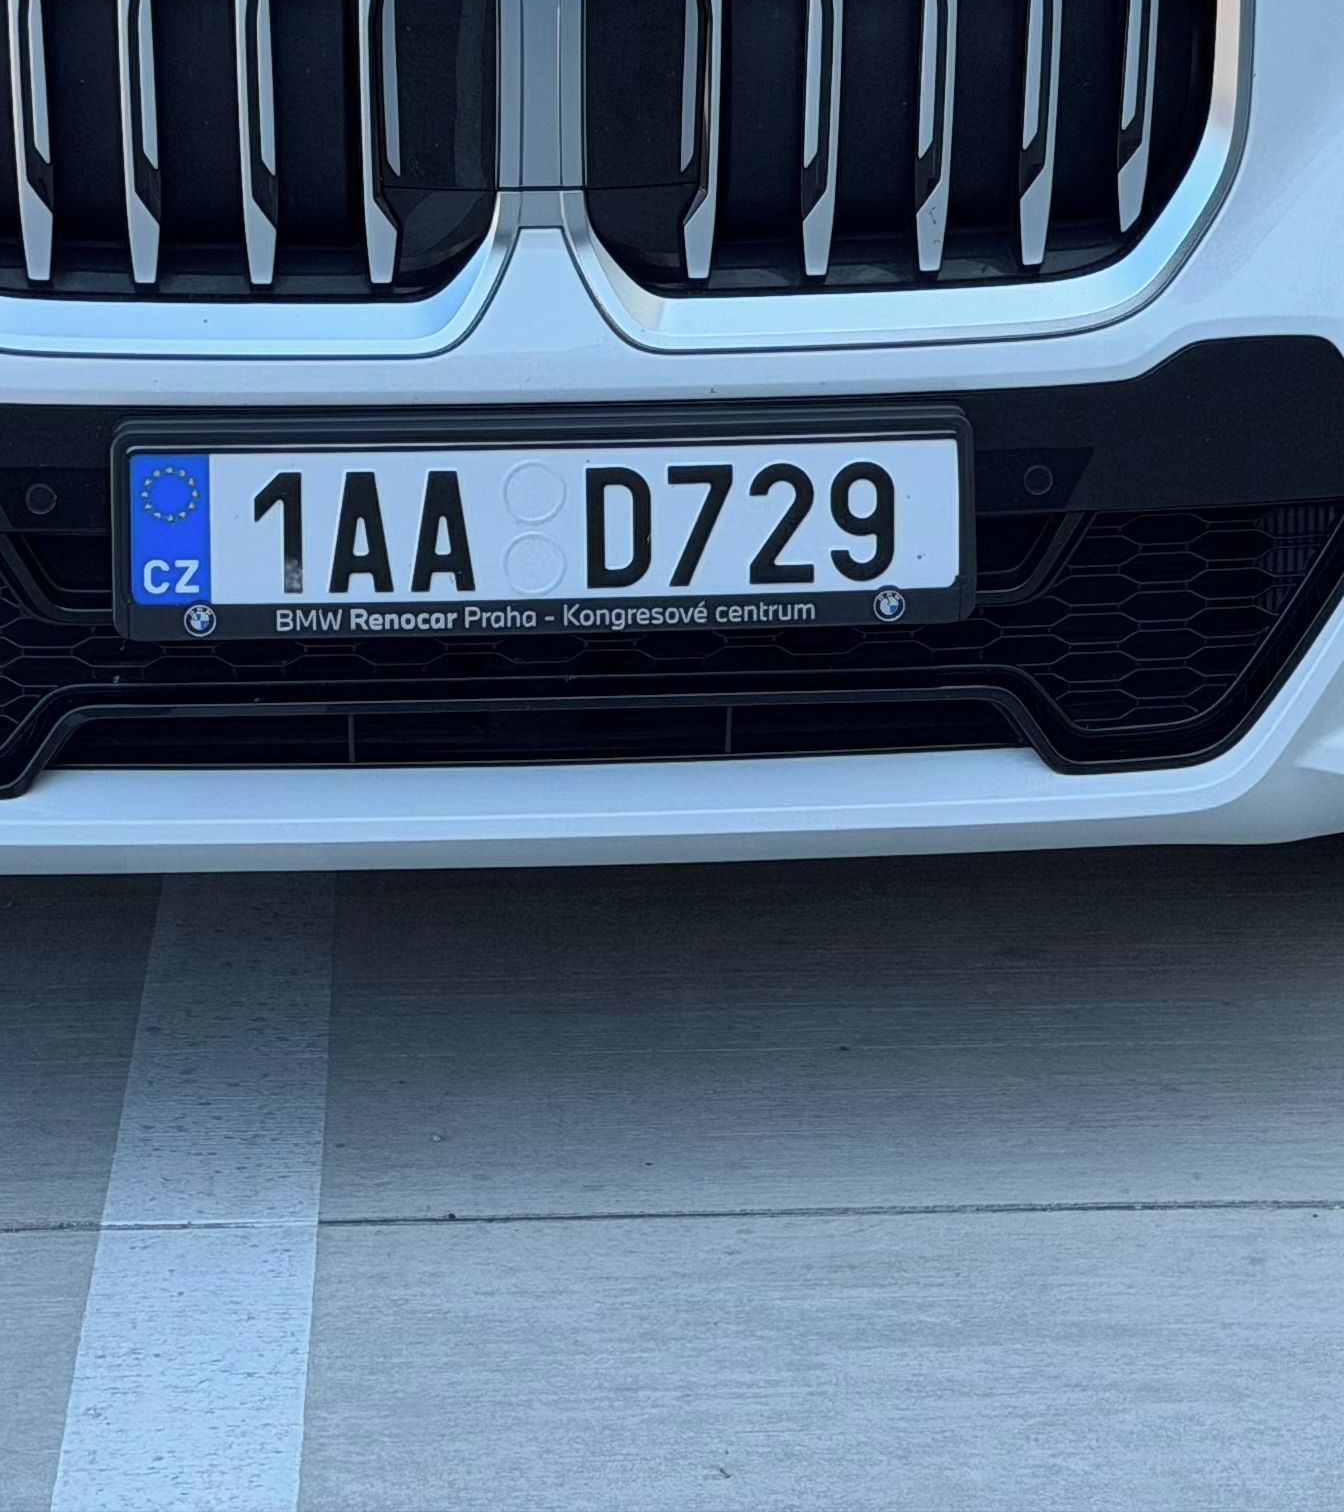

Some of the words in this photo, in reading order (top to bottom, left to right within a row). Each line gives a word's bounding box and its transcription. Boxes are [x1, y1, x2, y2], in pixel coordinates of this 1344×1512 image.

[254, 470, 476, 594] 1AA
[585, 461, 896, 590] D729
[143, 559, 201, 595] CZ
[275, 609, 343, 632] BMW
[349, 608, 458, 631] Renocar
[464, 605, 537, 629] Praha
[563, 601, 708, 631] Kongresové
[715, 601, 817, 623] centrum
